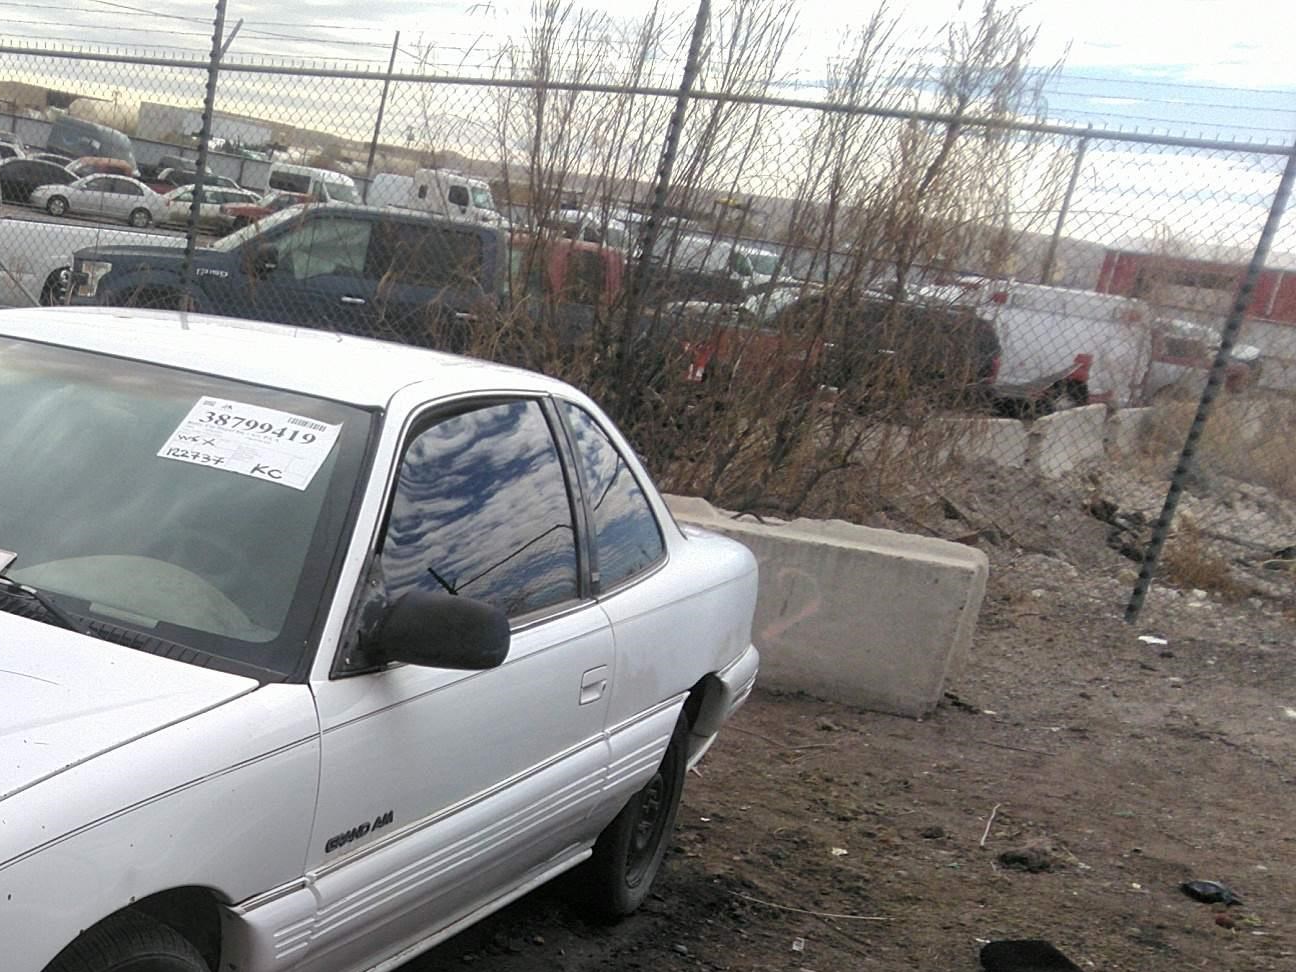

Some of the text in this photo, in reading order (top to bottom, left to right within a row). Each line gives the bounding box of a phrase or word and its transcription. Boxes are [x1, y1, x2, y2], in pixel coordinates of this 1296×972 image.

[198, 410, 317, 445] 38799419
[250, 463, 283, 480] KC
[325, 809, 395, 854] GRAND AM
